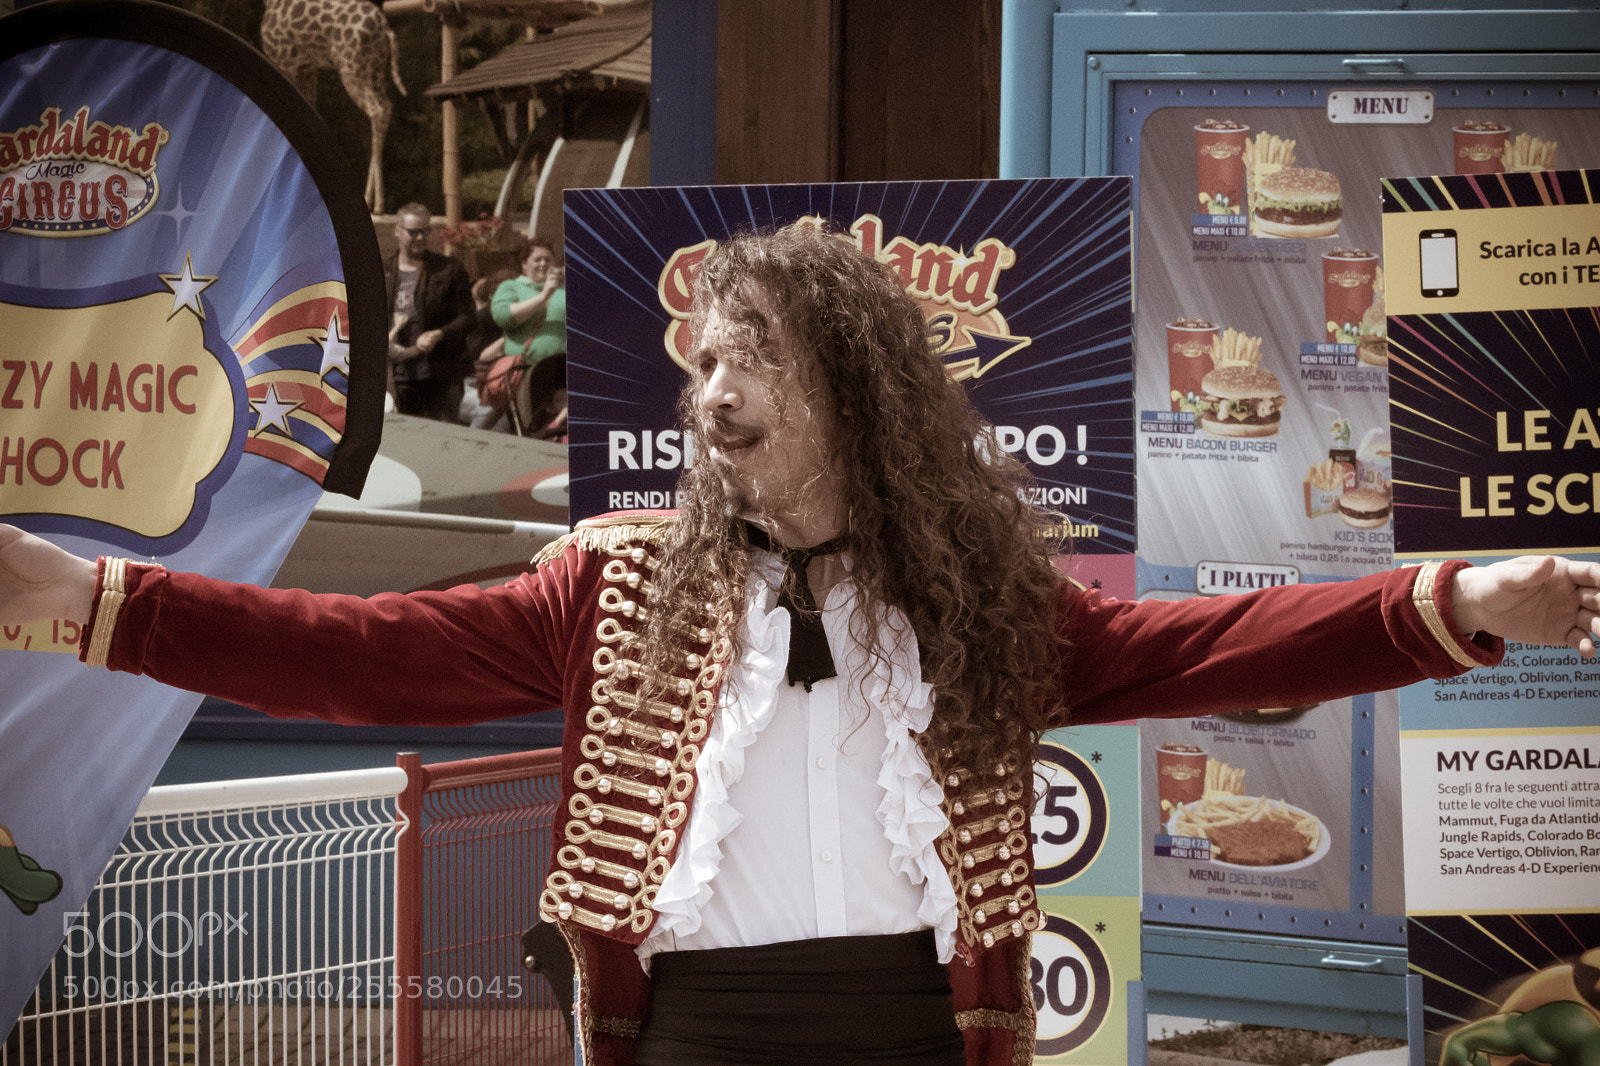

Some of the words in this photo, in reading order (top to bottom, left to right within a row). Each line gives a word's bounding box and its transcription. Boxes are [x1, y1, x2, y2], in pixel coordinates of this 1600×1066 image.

[1354, 98, 1408, 115] MENU
[26, 163, 86, 180] Magic
[1212, 216, 1228, 224] MENU
[1193, 227, 1209, 235] MENU
[1211, 227, 1224, 235] MAXI
[1193, 241, 1228, 251] MENU
[1480, 239, 1556, 259] Scarica
[1562, 237, 1580, 256] la
[1519, 272, 1557, 286] con
[1563, 266, 1567, 284] i
[1318, 344, 1333, 352] MENU
[1301, 356, 1318, 364] MENU
[1319, 356, 1334, 364] MAXI
[1301, 370, 1337, 381] MENU
[1341, 371, 1382, 382] VEGAN
[1, 360, 53, 409] ZY
[70, 361, 198, 414] MAGIC
[1159, 424, 1173, 432] MAXI
[1496, 410, 1552, 452] LE
[1563, 408, 1600, 450] A
[1148, 437, 1182, 448] MENU
[1187, 439, 1226, 451] BACON
[1230, 441, 1277, 452] BURGER
[0, 437, 125, 490] HOCK
[1148, 451, 1172, 459] panino
[1182, 453, 1206, 461] patate
[1209, 453, 1228, 461] fritte
[1238, 454, 1259, 462] bibita
[609, 491, 670, 509] RENDI
[1460, 475, 1515, 518] LE
[1335, 530, 1365, 542] KID'S
[1369, 532, 1393, 543] BOX
[1308, 543, 1351, 553] hamburger
[1210, 570, 1216, 586] I
[1223, 571, 1286, 588] PIATTI
[1522, 655, 1577, 667] Colorado
[1581, 656, 1600, 665] Bo
[1434, 676, 1468, 687] Space
[1471, 673, 1517, 686] Vertigo,
[1519, 672, 1572, 683] Oblivion,
[1435, 691, 1457, 702] San
[1459, 690, 1510, 700] Andreas
[1513, 689, 1535, 699] 4-D
[1539, 688, 1600, 700] Experienc
[1192, 721, 1225, 733] MENU
[1229, 723, 1258, 736] BLUE
[1261, 726, 1316, 740] TORNADO
[1437, 751, 1480, 772] MY
[1485, 748, 1600, 771] GARDAL
[1438, 783, 1472, 795] Scegli
[1475, 783, 1482, 794] 8
[1485, 782, 1502, 793] fra
[1505, 782, 1516, 793] le
[1518, 781, 1568, 795] seguenti
[1438, 800, 1468, 810] tutte
[1471, 799, 1484, 810] le
[1485, 798, 1514, 809] volte
[1516, 798, 1537, 809] che
[1540, 798, 1565, 808] vuoi
[1031, 786, 1080, 845] 5
[1439, 816, 1498, 827] Mammut,
[1500, 815, 1529, 827] Fuga
[1531, 814, 1546, 825] da
[1549, 813, 1600, 824] Atlantid
[1440, 831, 1478, 845] Jungle
[1481, 831, 1525, 844] Rapids,
[1527, 830, 1584, 841] Colorado
[1171, 848, 1187, 858] MENU
[1440, 848, 1474, 861] Space
[1477, 847, 1523, 861] Vertigo,
[1525, 846, 1578, 859] Oblivion,
[1441, 864, 1462, 875] San
[1465, 863, 1516, 875] Andreas
[1518, 863, 1541, 874] 4-D
[1544, 862, 1600, 876] Experien
[1189, 869, 1225, 882] MENU
[1230, 872, 1319, 891] DELL'AVIATORE
